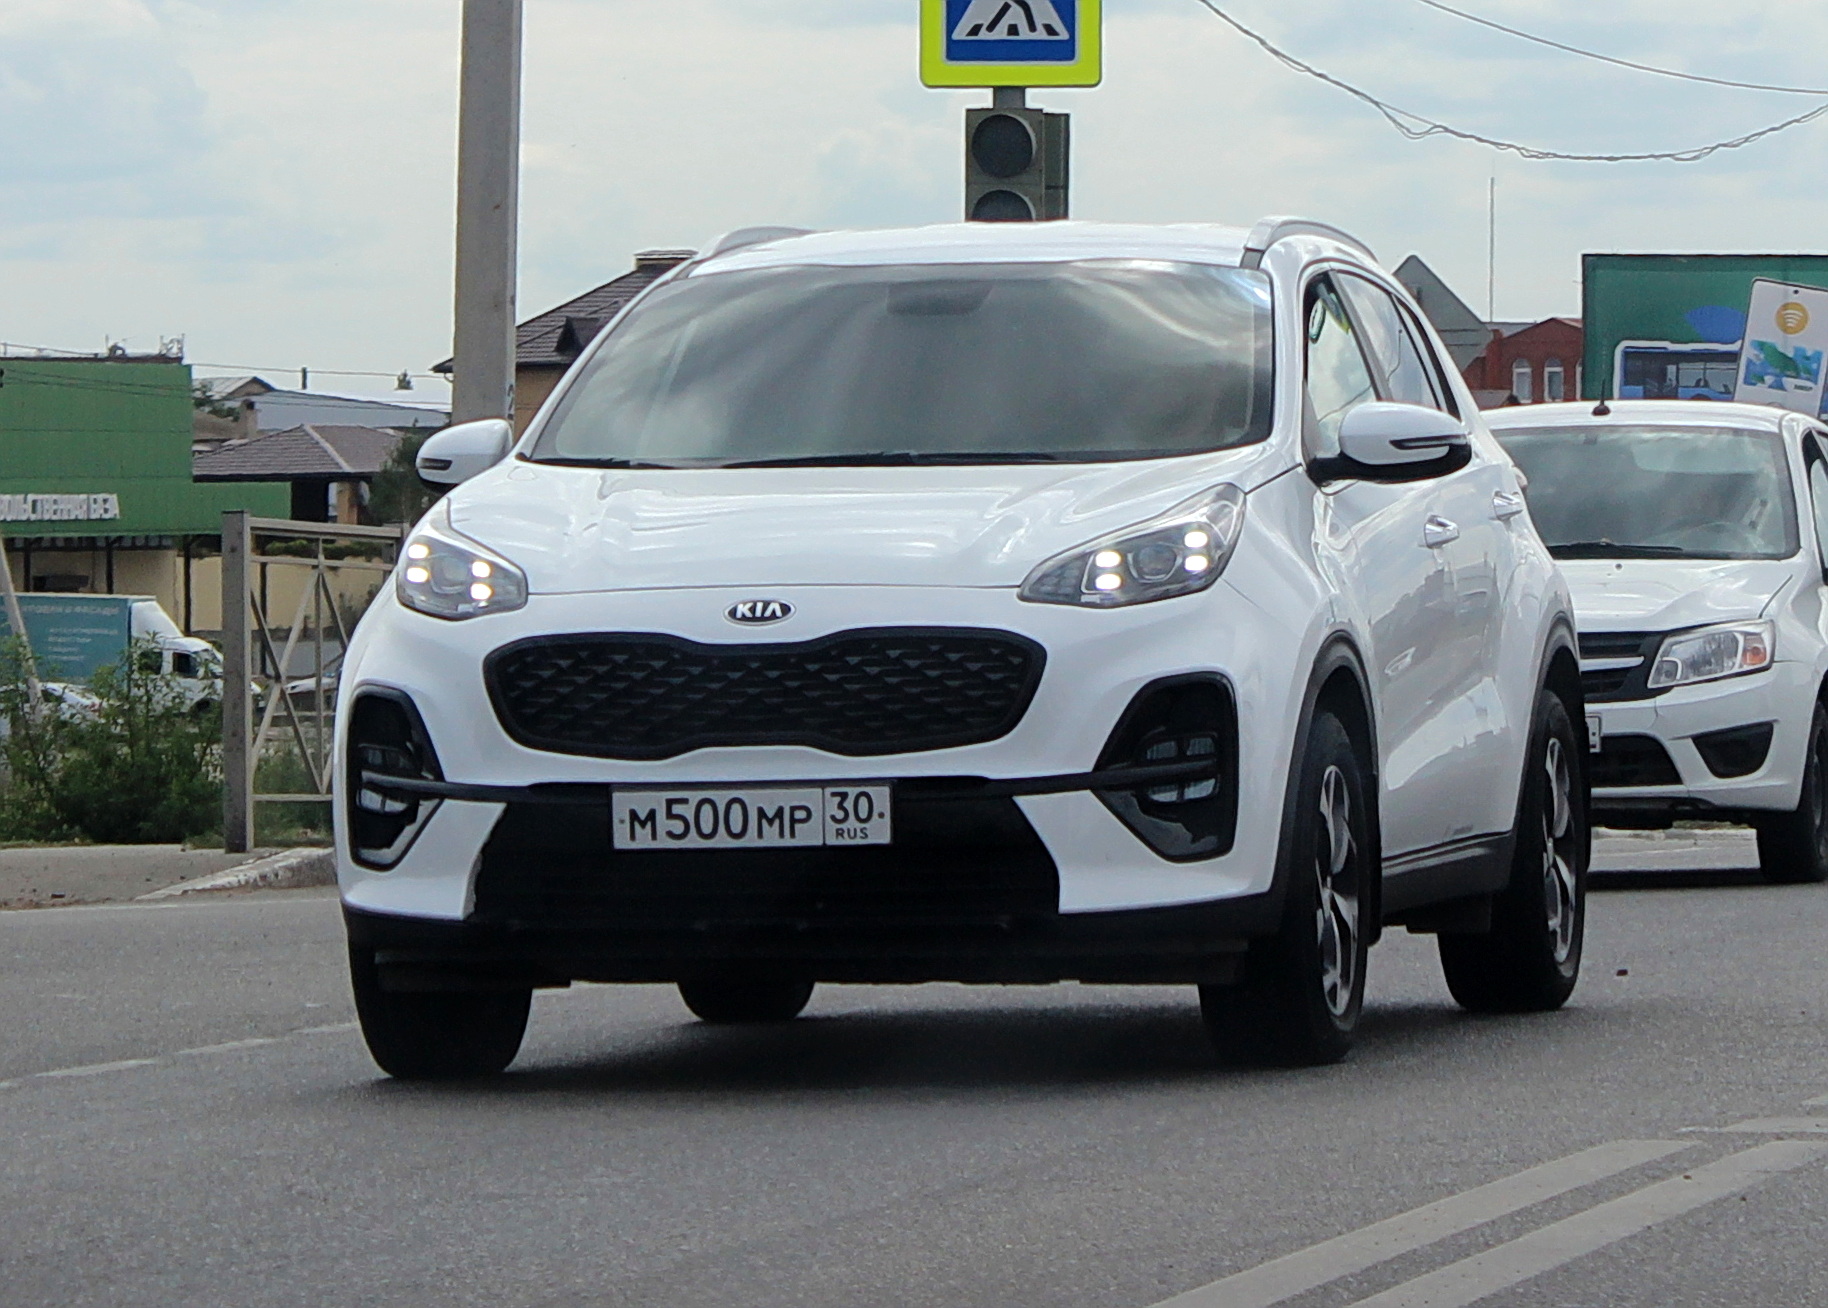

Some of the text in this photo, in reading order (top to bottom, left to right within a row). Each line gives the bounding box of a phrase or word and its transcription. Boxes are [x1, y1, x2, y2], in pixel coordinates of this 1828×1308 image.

[735, 601, 783, 619] KIA
[628, 790, 876, 841] М500МР 30
[835, 826, 870, 840] RUS
